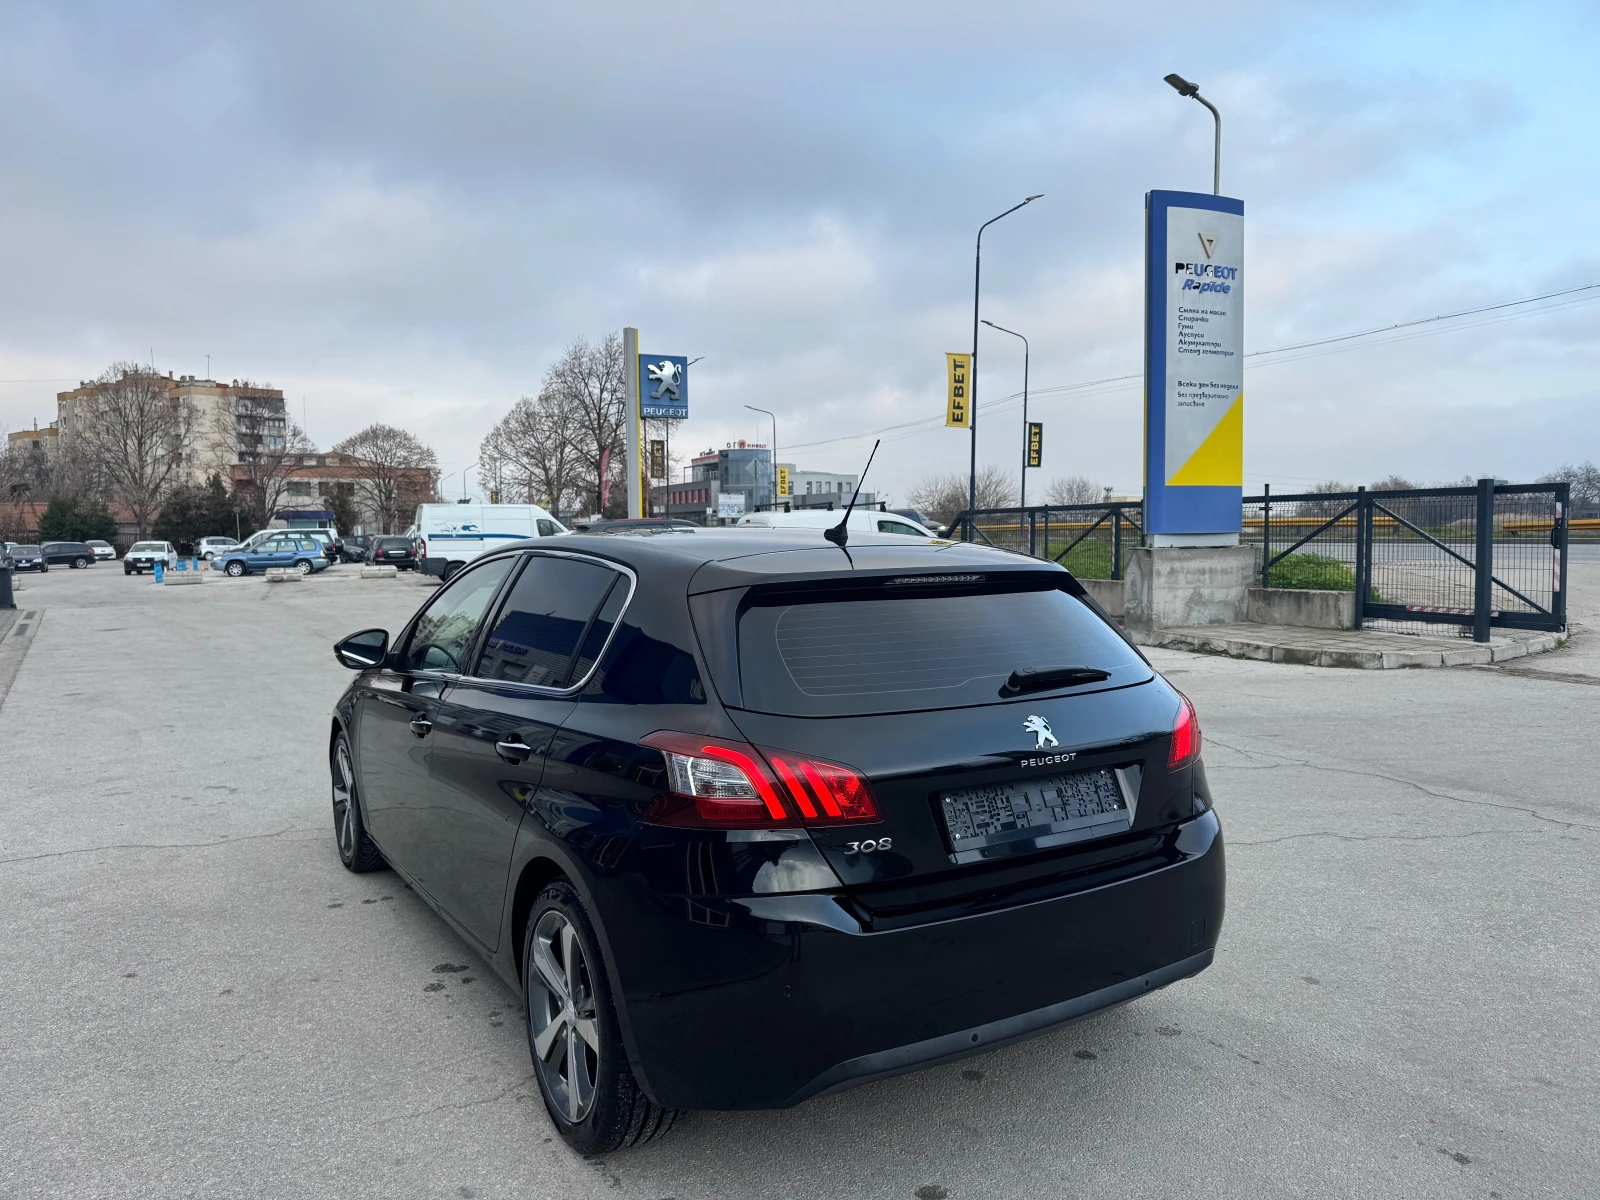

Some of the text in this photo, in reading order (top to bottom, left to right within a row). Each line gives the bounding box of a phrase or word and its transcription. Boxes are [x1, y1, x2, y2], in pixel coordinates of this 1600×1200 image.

[1175, 262, 1238, 280] PEUGEOT
[1182, 279, 1231, 294] Rapide
[1178, 306, 1199, 314] Смяна
[1178, 314, 1209, 323] Спирачки
[1178, 322, 1194, 330] Гуми
[1178, 330, 1205, 339] Ауспуси
[1178, 339, 1222, 348] Акумулатори
[1178, 346, 1235, 357] Стенд геометрия
[1177, 380, 1197, 388] Всеки
[1210, 381, 1219, 389] без
[952, 358, 965, 423] EFBET
[643, 407, 687, 417] PEUGEOT
[1030, 425, 1040, 466] EFBET
[779, 468, 787, 495] EFBET
[1020, 752, 1077, 769] PEUGEOT
[843, 837, 892, 855] 308
